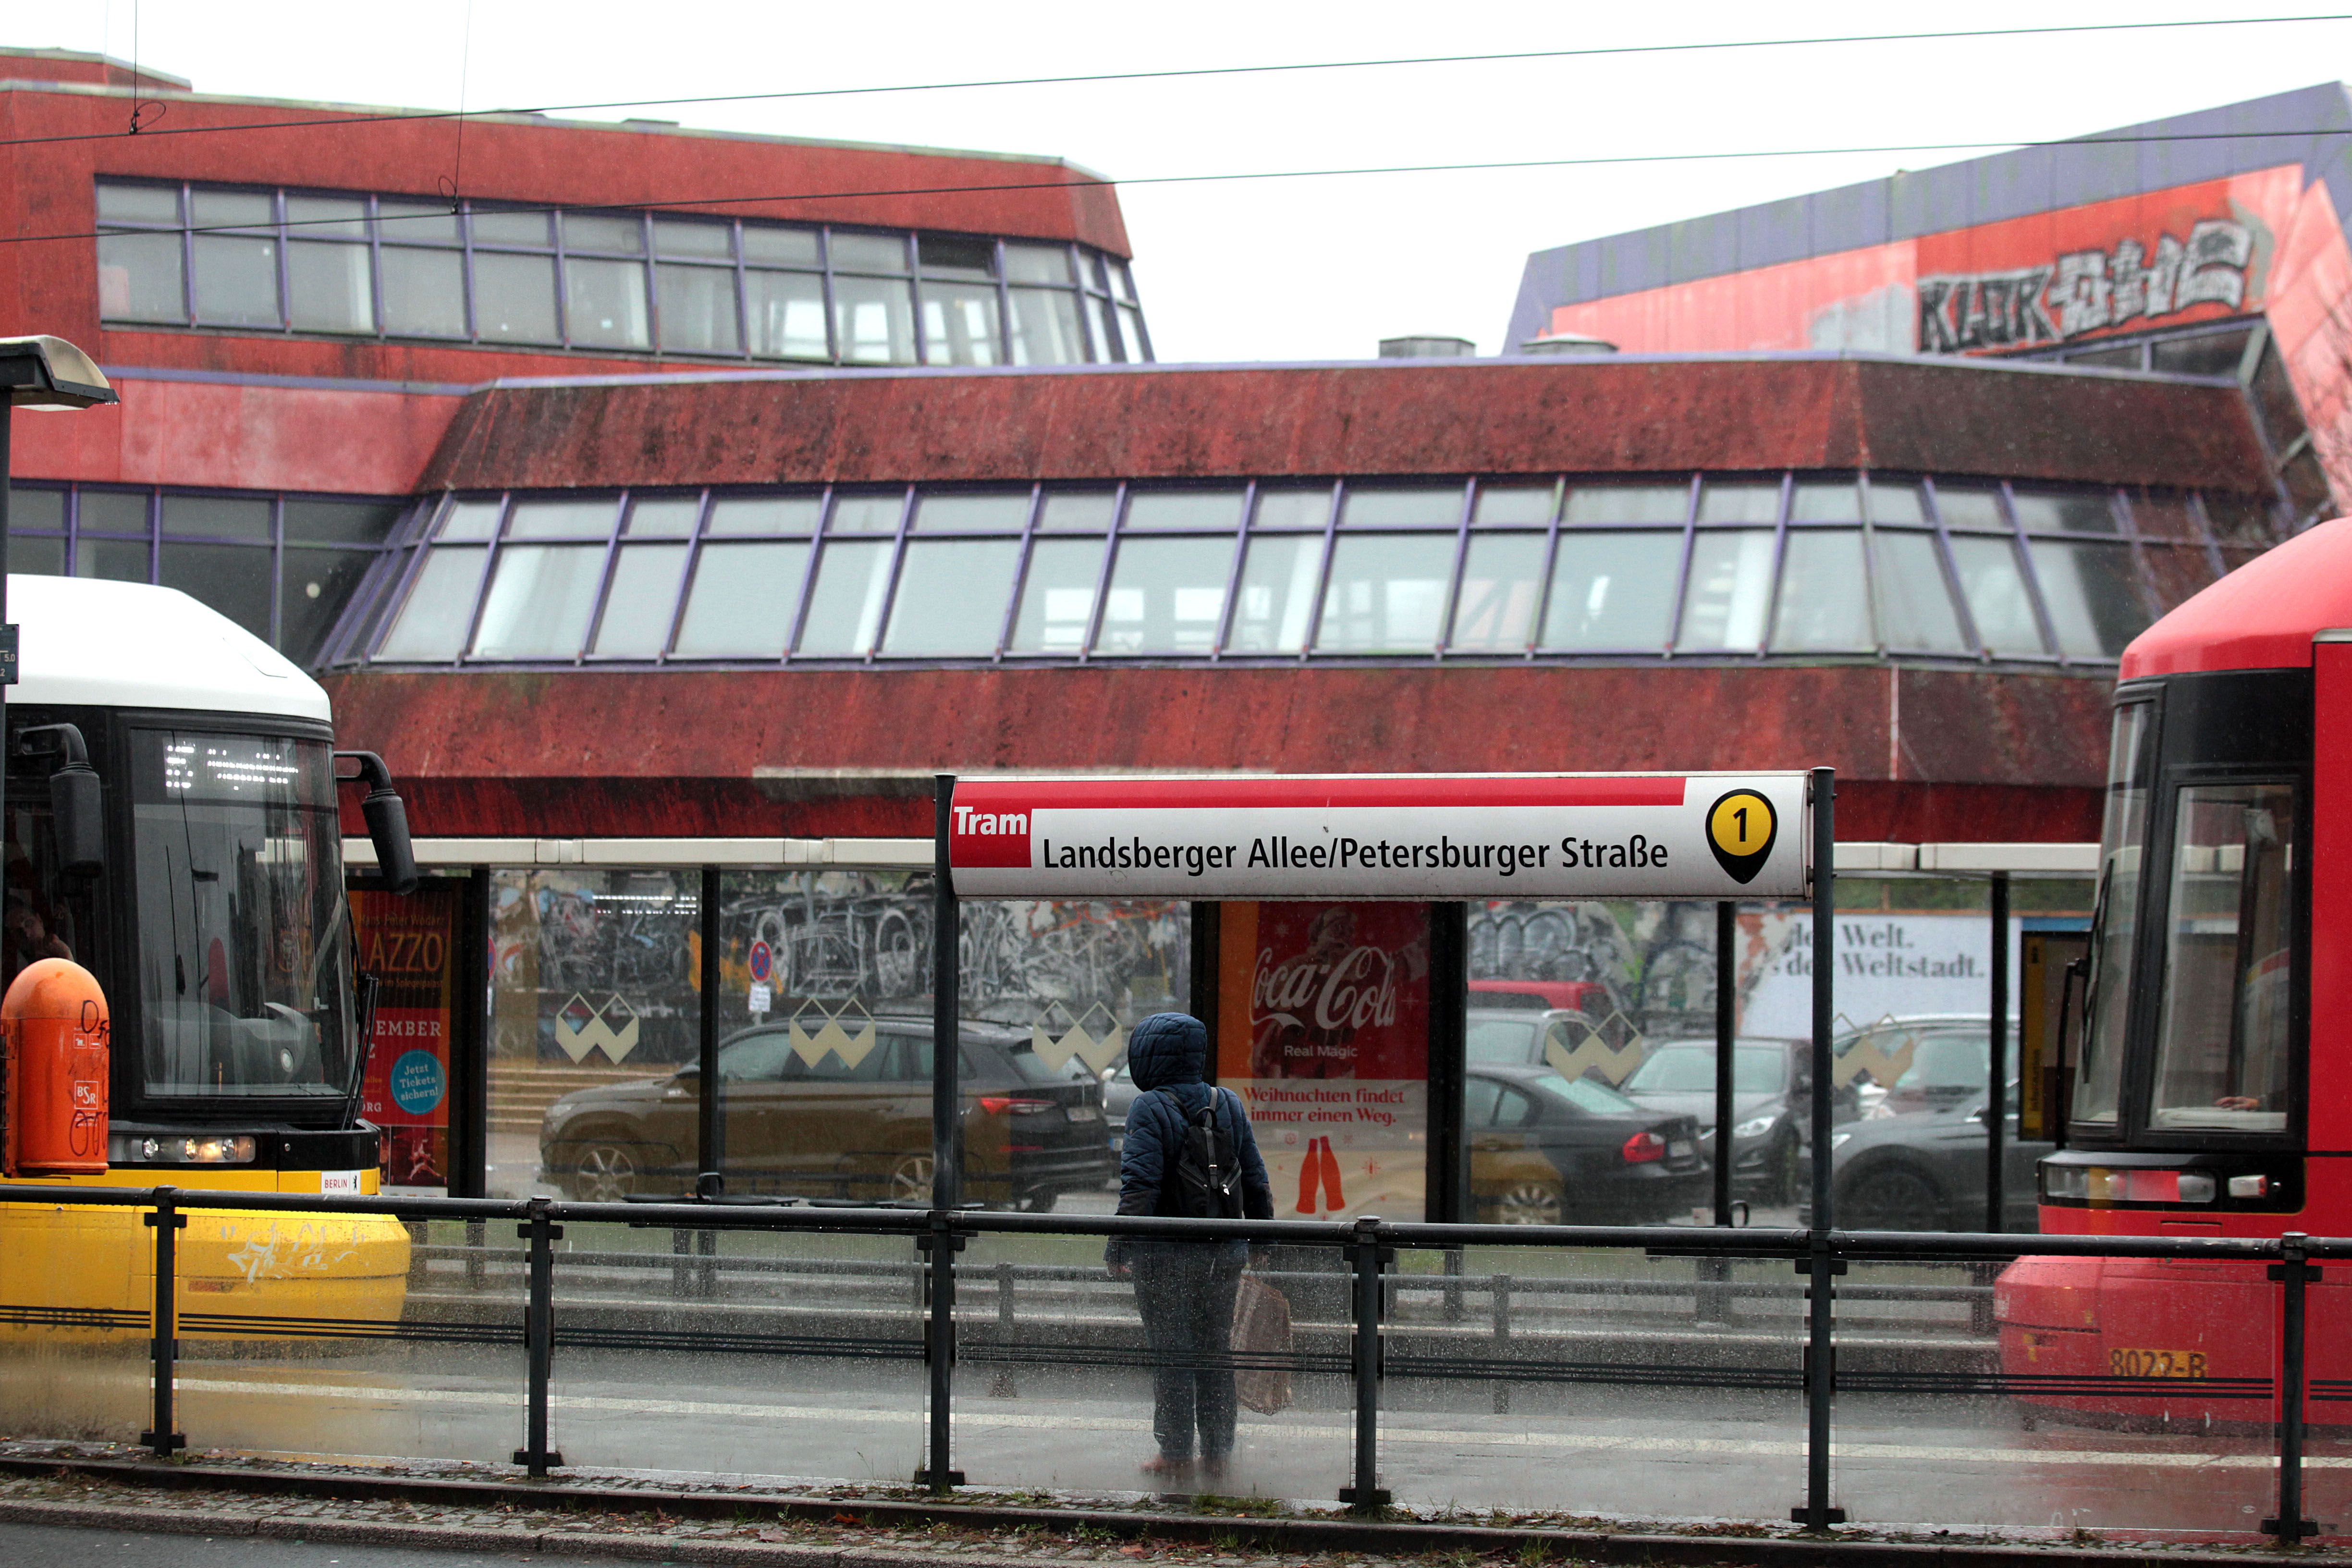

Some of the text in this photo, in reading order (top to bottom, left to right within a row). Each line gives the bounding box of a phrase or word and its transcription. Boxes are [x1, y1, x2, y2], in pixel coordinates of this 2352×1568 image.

[954, 806, 1027, 835] Tram
[1732, 808, 1748, 842] 1
[1044, 834, 1668, 877] Landsberger Allee/Petersburger Straße
[1841, 923, 1914, 948] Welt.
[1841, 952, 1985, 978] Weltstadt.
[1250, 945, 1396, 1030] Coca-Cola
[1284, 1046, 1358, 1060] Real Magic
[404, 1064, 429, 1075] Jetzt
[400, 1075, 436, 1089] Tickets
[77, 1086, 96, 1104] BSR
[401, 1087, 439, 1101] sichern!
[1243, 1087, 1404, 1103] Weihnachten findet
[1251, 1107, 1397, 1127] immer einen Weg.
[325, 1179, 347, 1188] BERLIN
